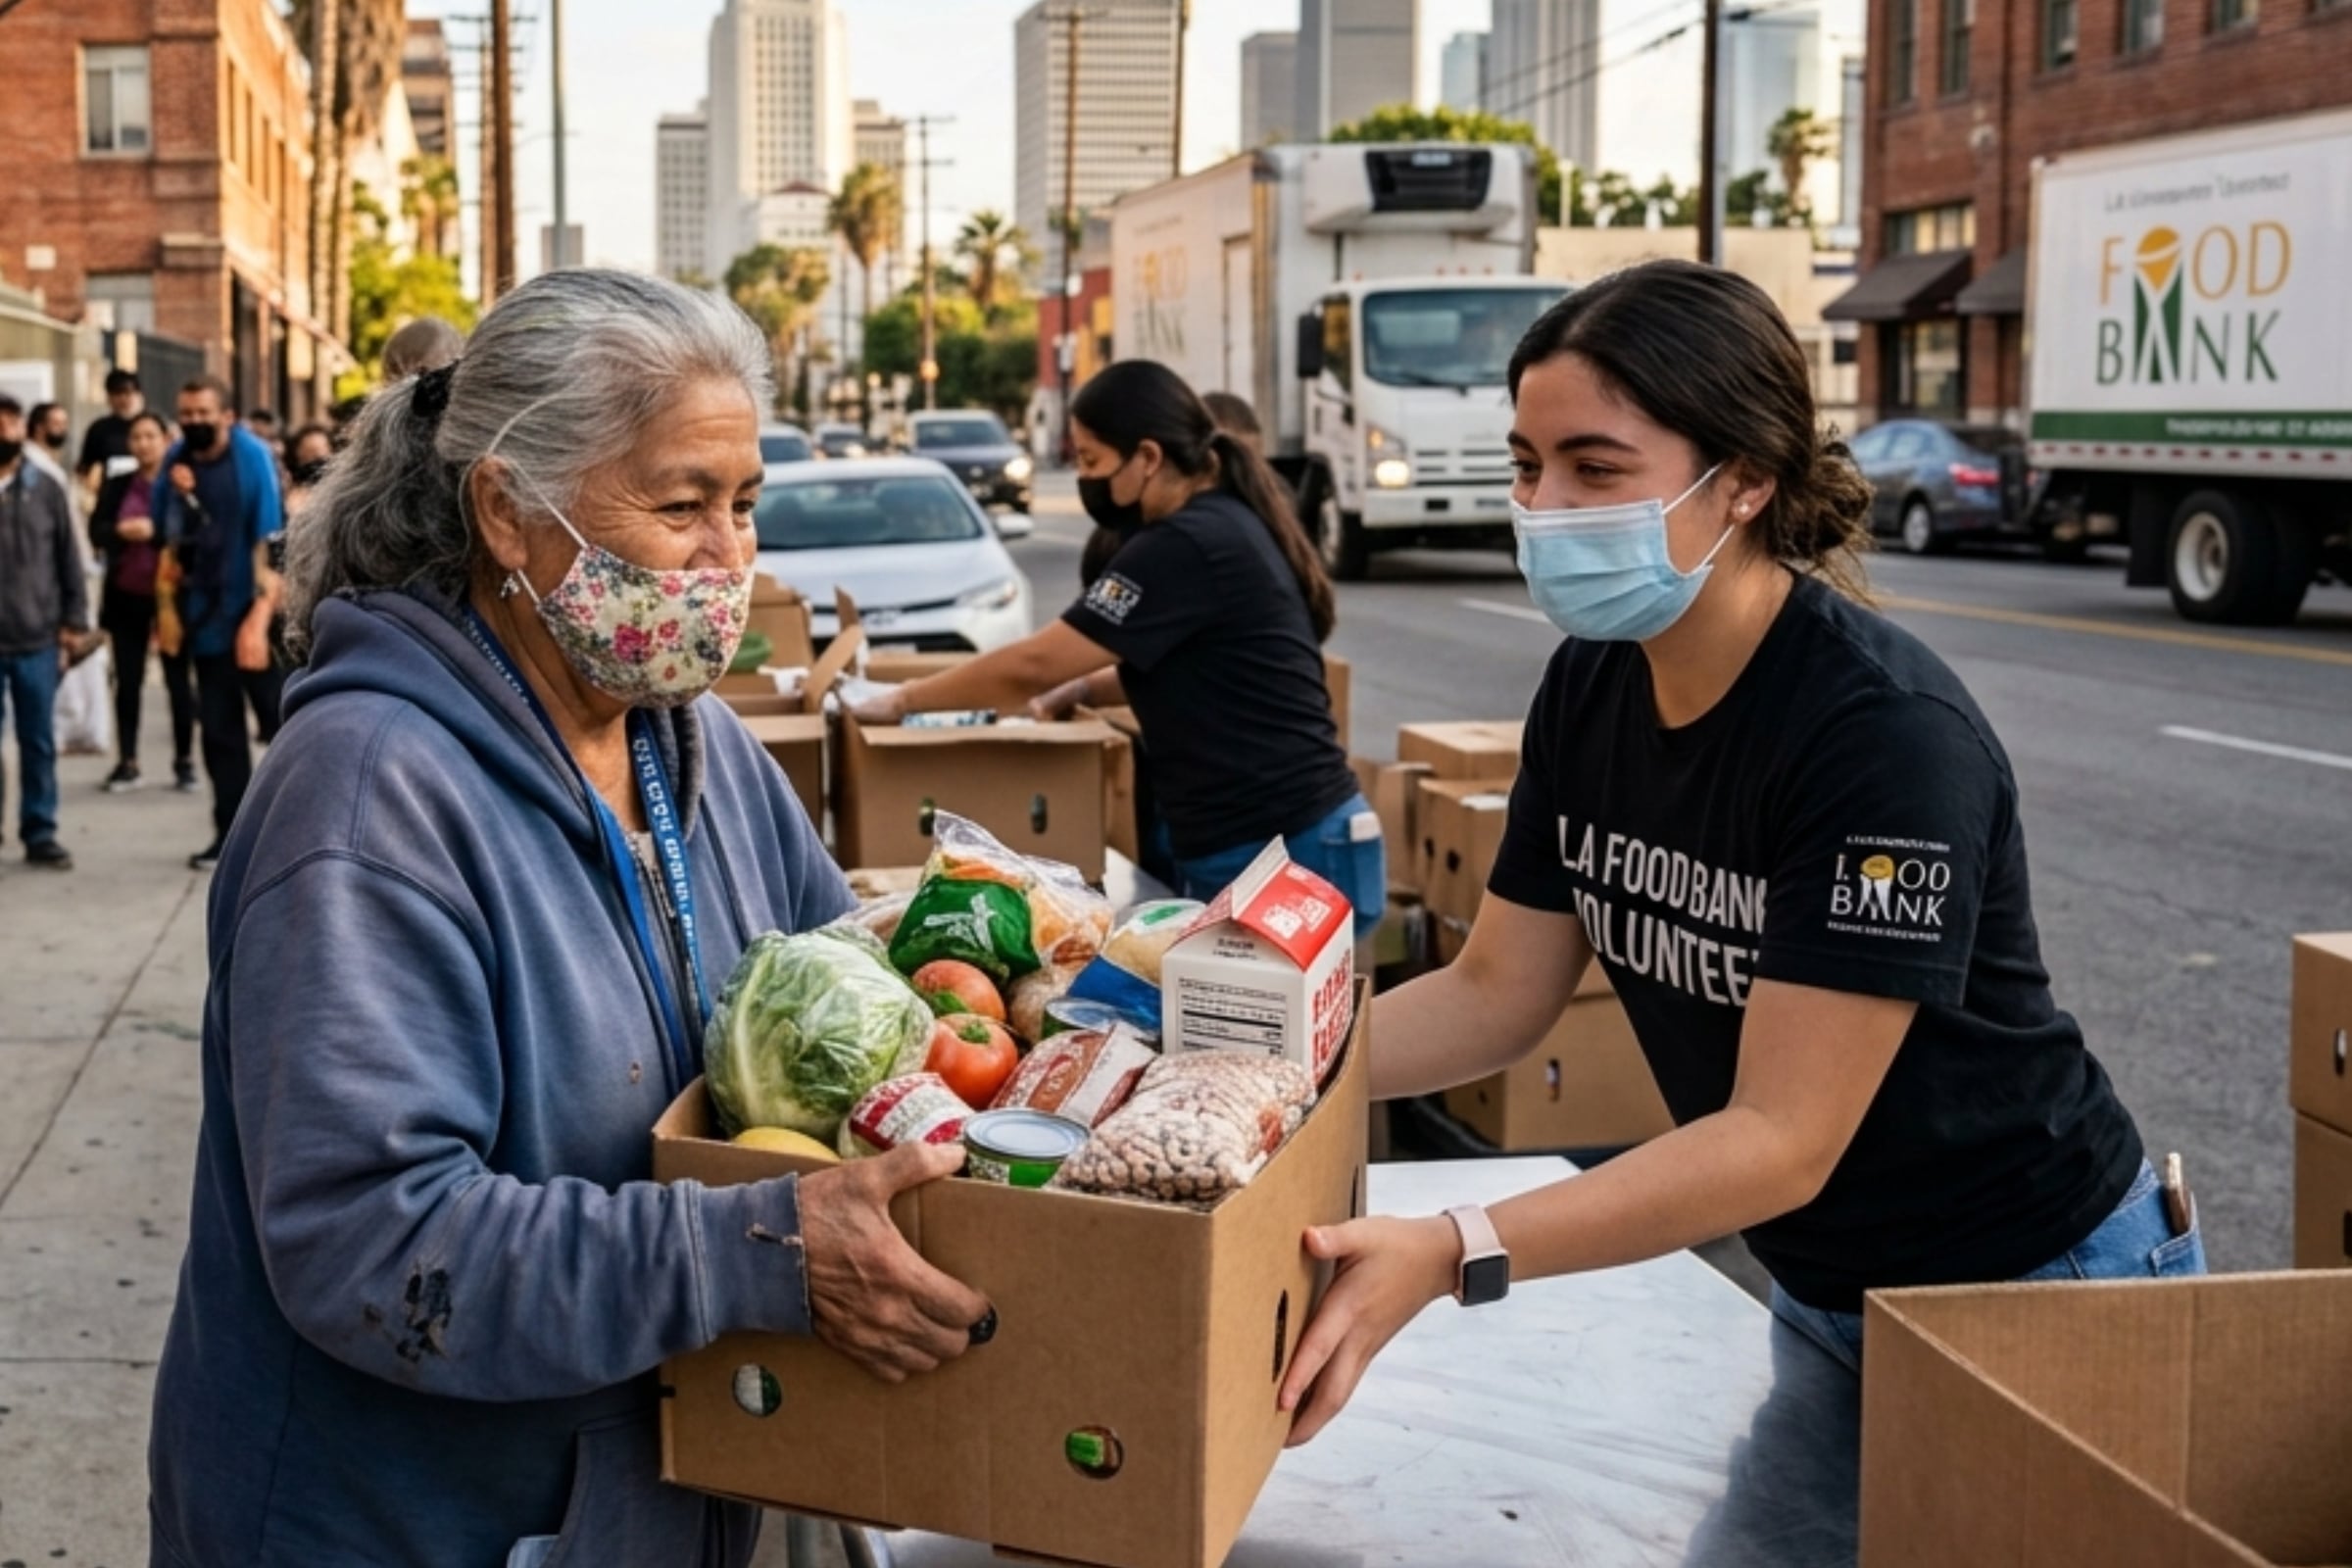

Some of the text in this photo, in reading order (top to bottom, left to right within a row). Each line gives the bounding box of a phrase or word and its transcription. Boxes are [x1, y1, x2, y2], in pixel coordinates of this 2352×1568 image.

[2100, 220, 2292, 307] FOOD
[2096, 310, 2281, 387] BANK
[1558, 814, 1594, 879] LA
[1830, 885, 1946, 927] BANK
[1572, 886, 1760, 1007] OLUNTEE
